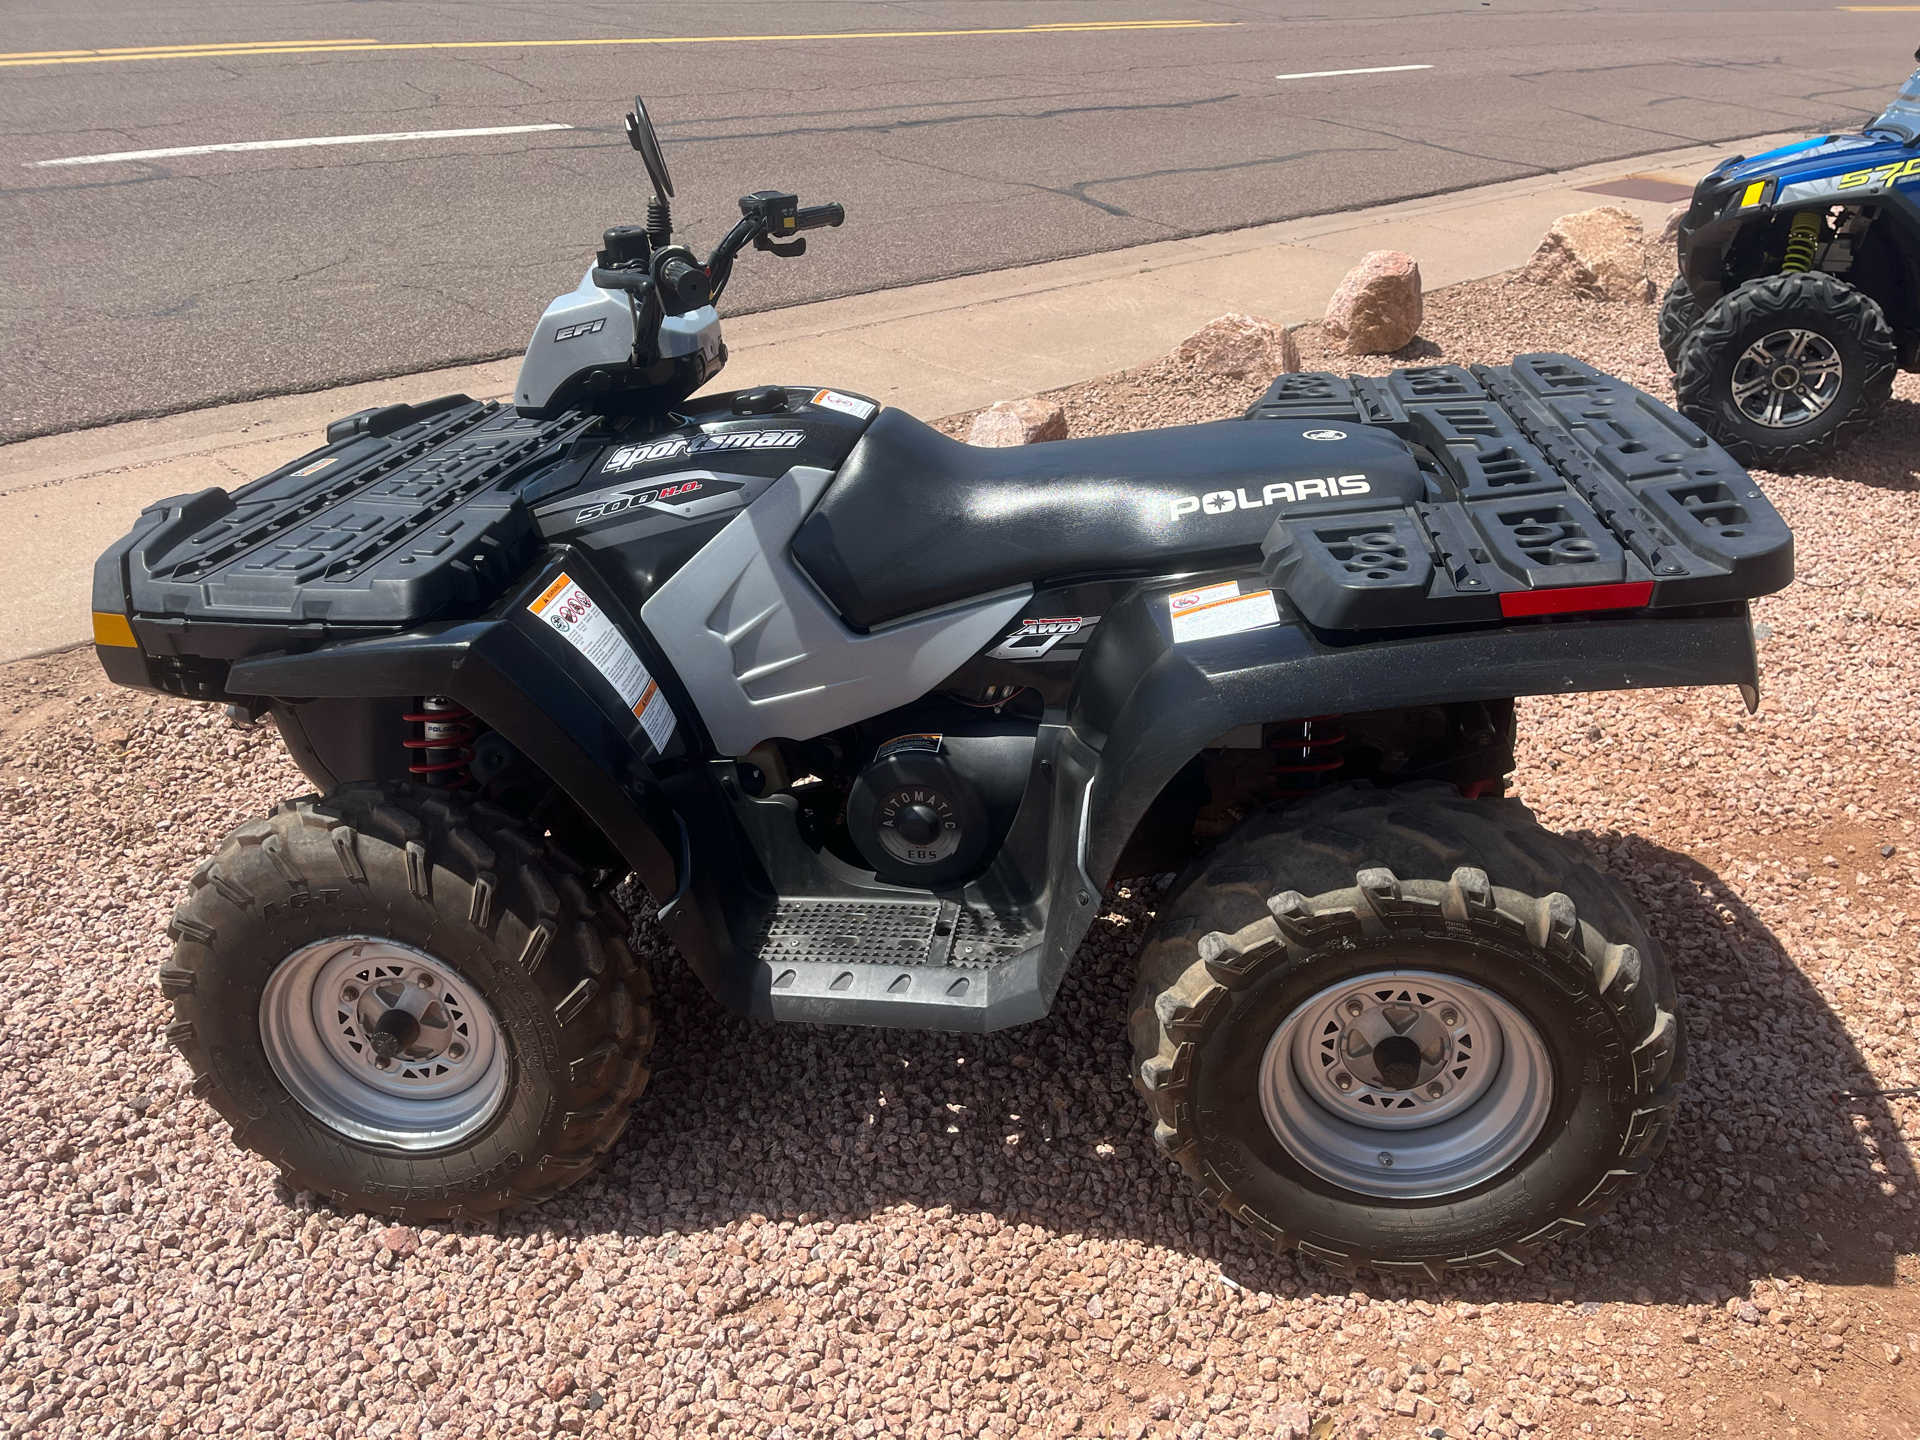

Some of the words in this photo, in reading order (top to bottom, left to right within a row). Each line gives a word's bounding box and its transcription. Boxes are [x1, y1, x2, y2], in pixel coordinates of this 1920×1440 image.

[555, 319, 605, 342] EFI
[601, 429, 807, 474] Sportsman
[575, 490, 660, 524] 500
[660, 481, 702, 499] H.O.
[1169, 474, 1371, 521] POLARIS
[1208, 596, 1244, 608] WARNING
[1017, 622, 1081, 635] AWD
[883, 790, 956, 829] AUTOMATIC
[908, 850, 937, 859] EBS
[361, 1150, 524, 1202] CARLISLE
[413, 1173, 431, 1183] USA
[1480, 1221, 1495, 1231] FOR
[1403, 1233, 1439, 1243] SERVICE
